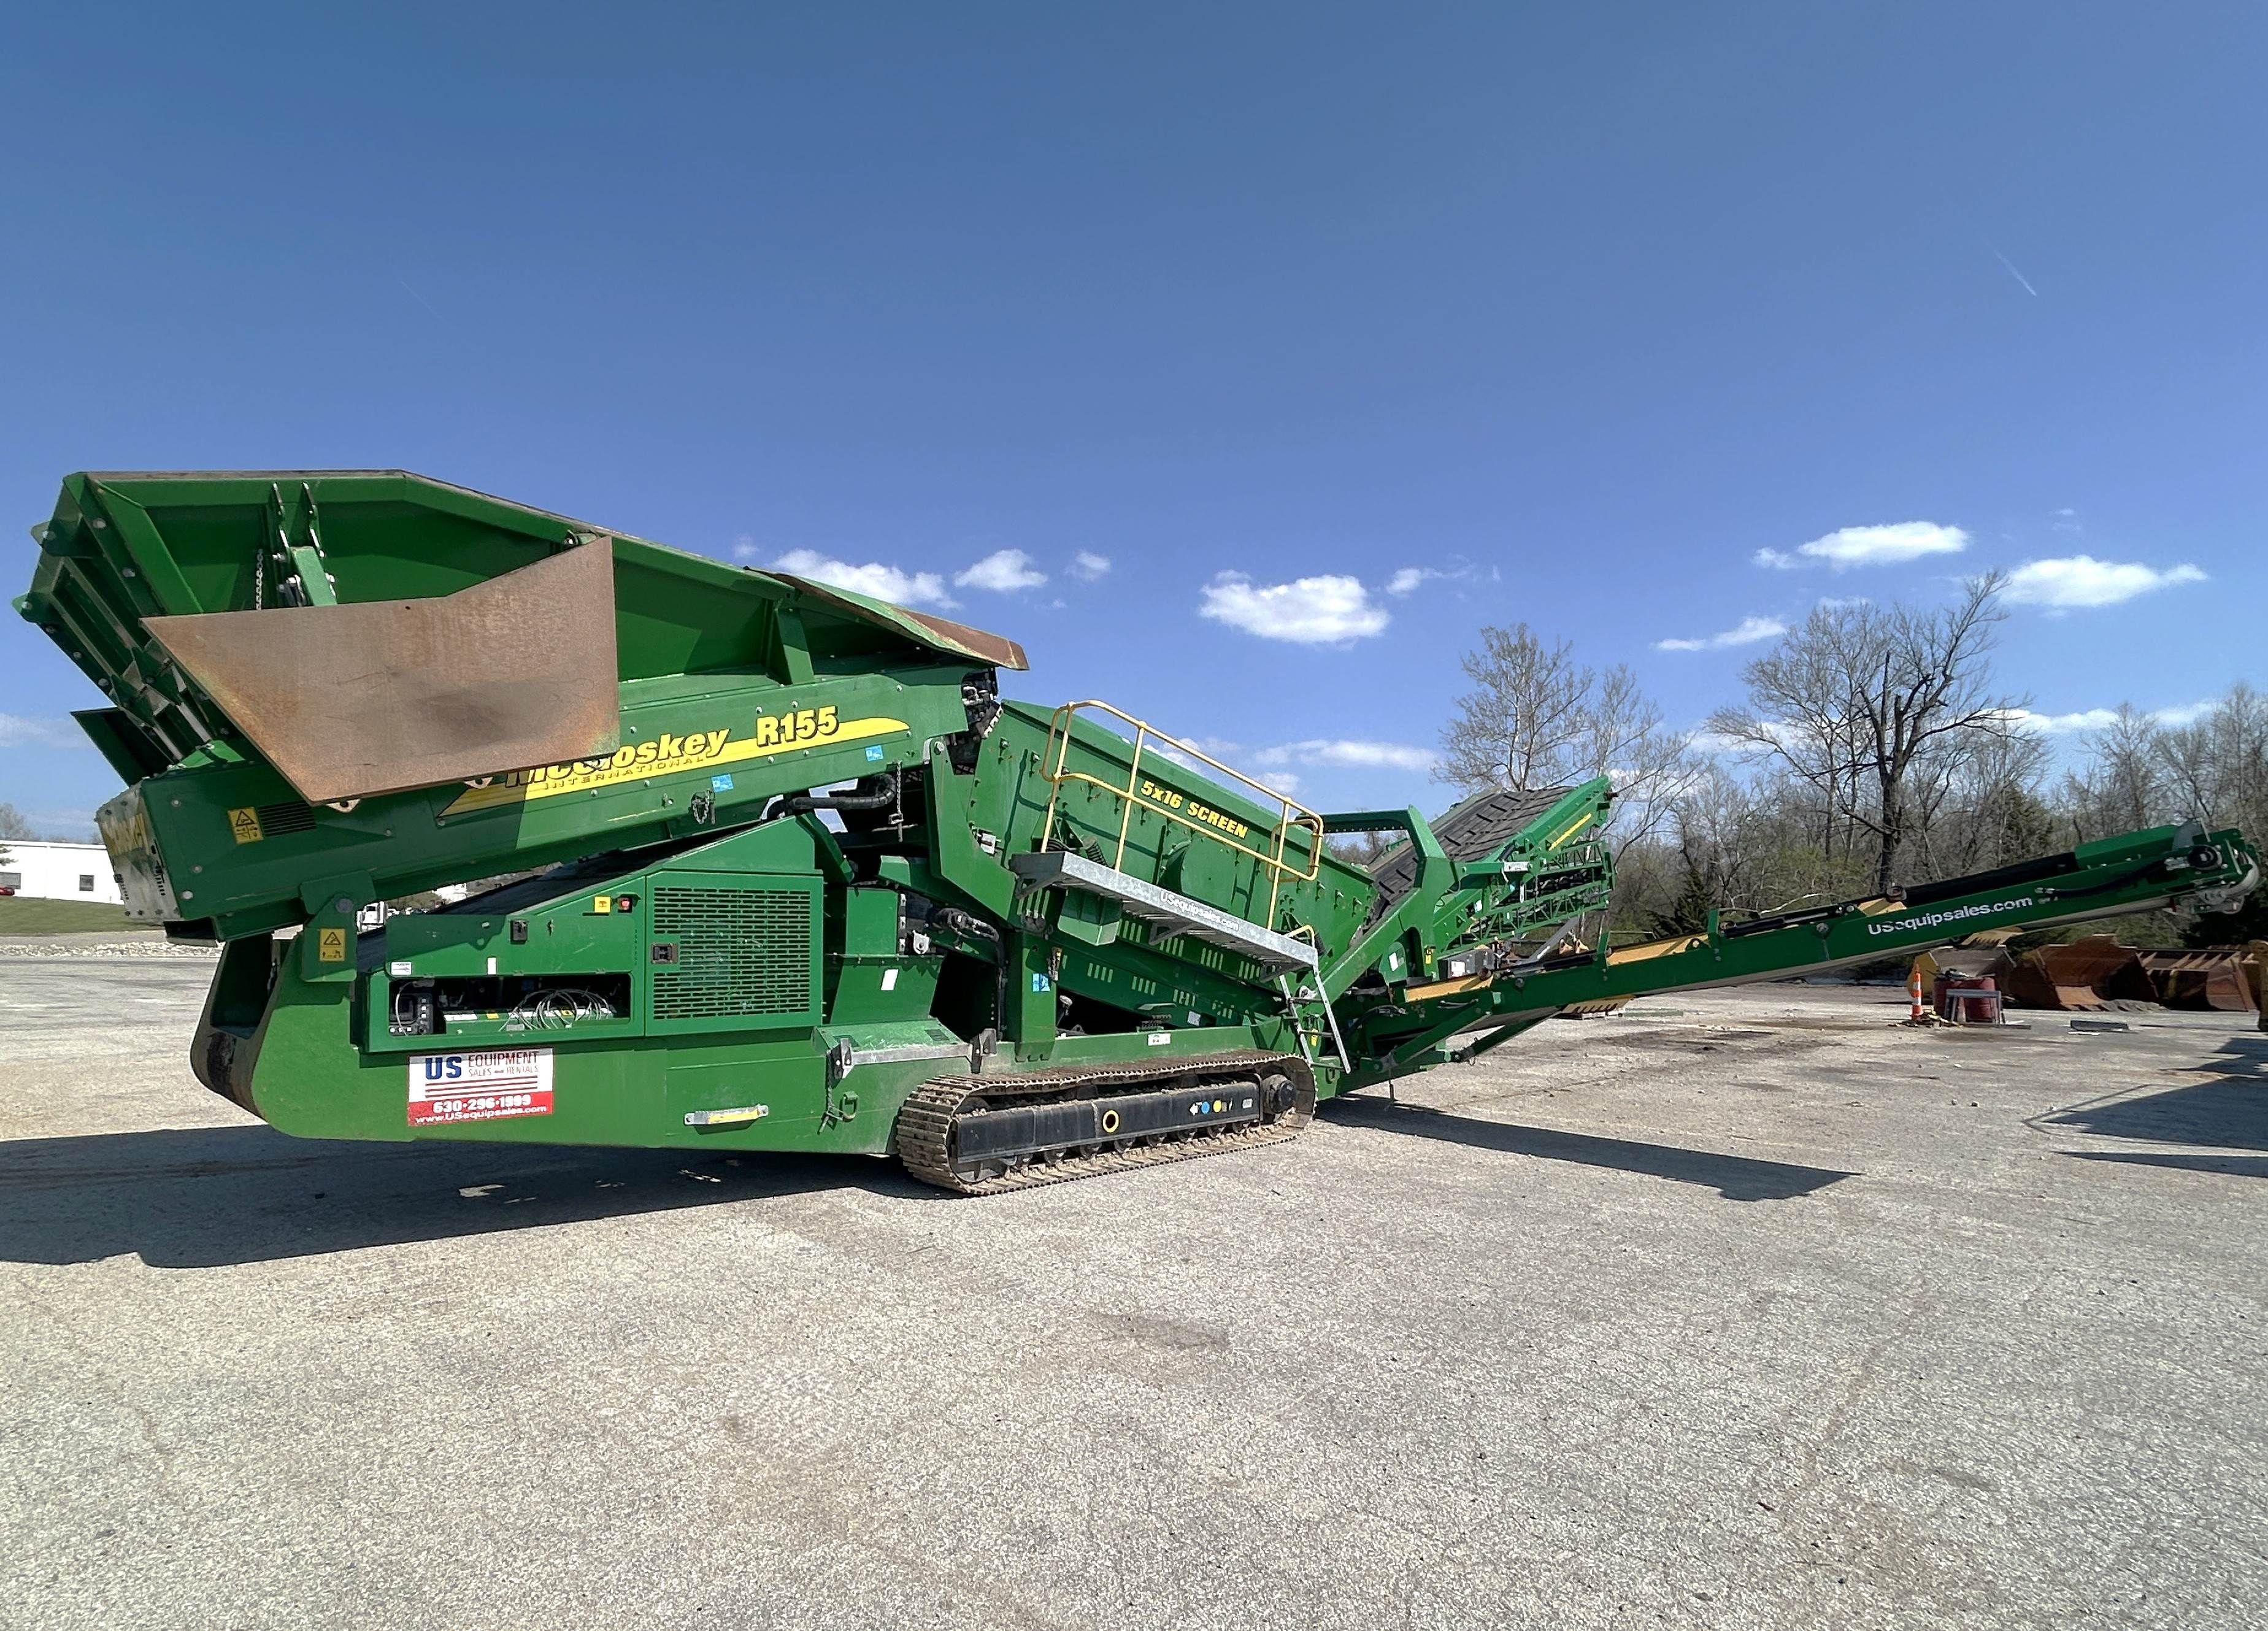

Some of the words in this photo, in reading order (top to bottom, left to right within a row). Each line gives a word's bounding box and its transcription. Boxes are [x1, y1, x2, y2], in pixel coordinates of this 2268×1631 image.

[756, 705, 840, 747] R155
[544, 755, 704, 790] INTERNATIONAL
[1140, 780, 1183, 809] 5x16
[1186, 801, 1249, 839] SCREEN
[1160, 889, 1239, 932] USequipsales.com
[425, 1056, 462, 1080] US
[468, 1051, 540, 1067] EQUIPMENT
[468, 1068, 492, 1077] SALES
[507, 1065, 539, 1075] RENTALS
[415, 1105, 547, 1124] www.USequipsales.com
